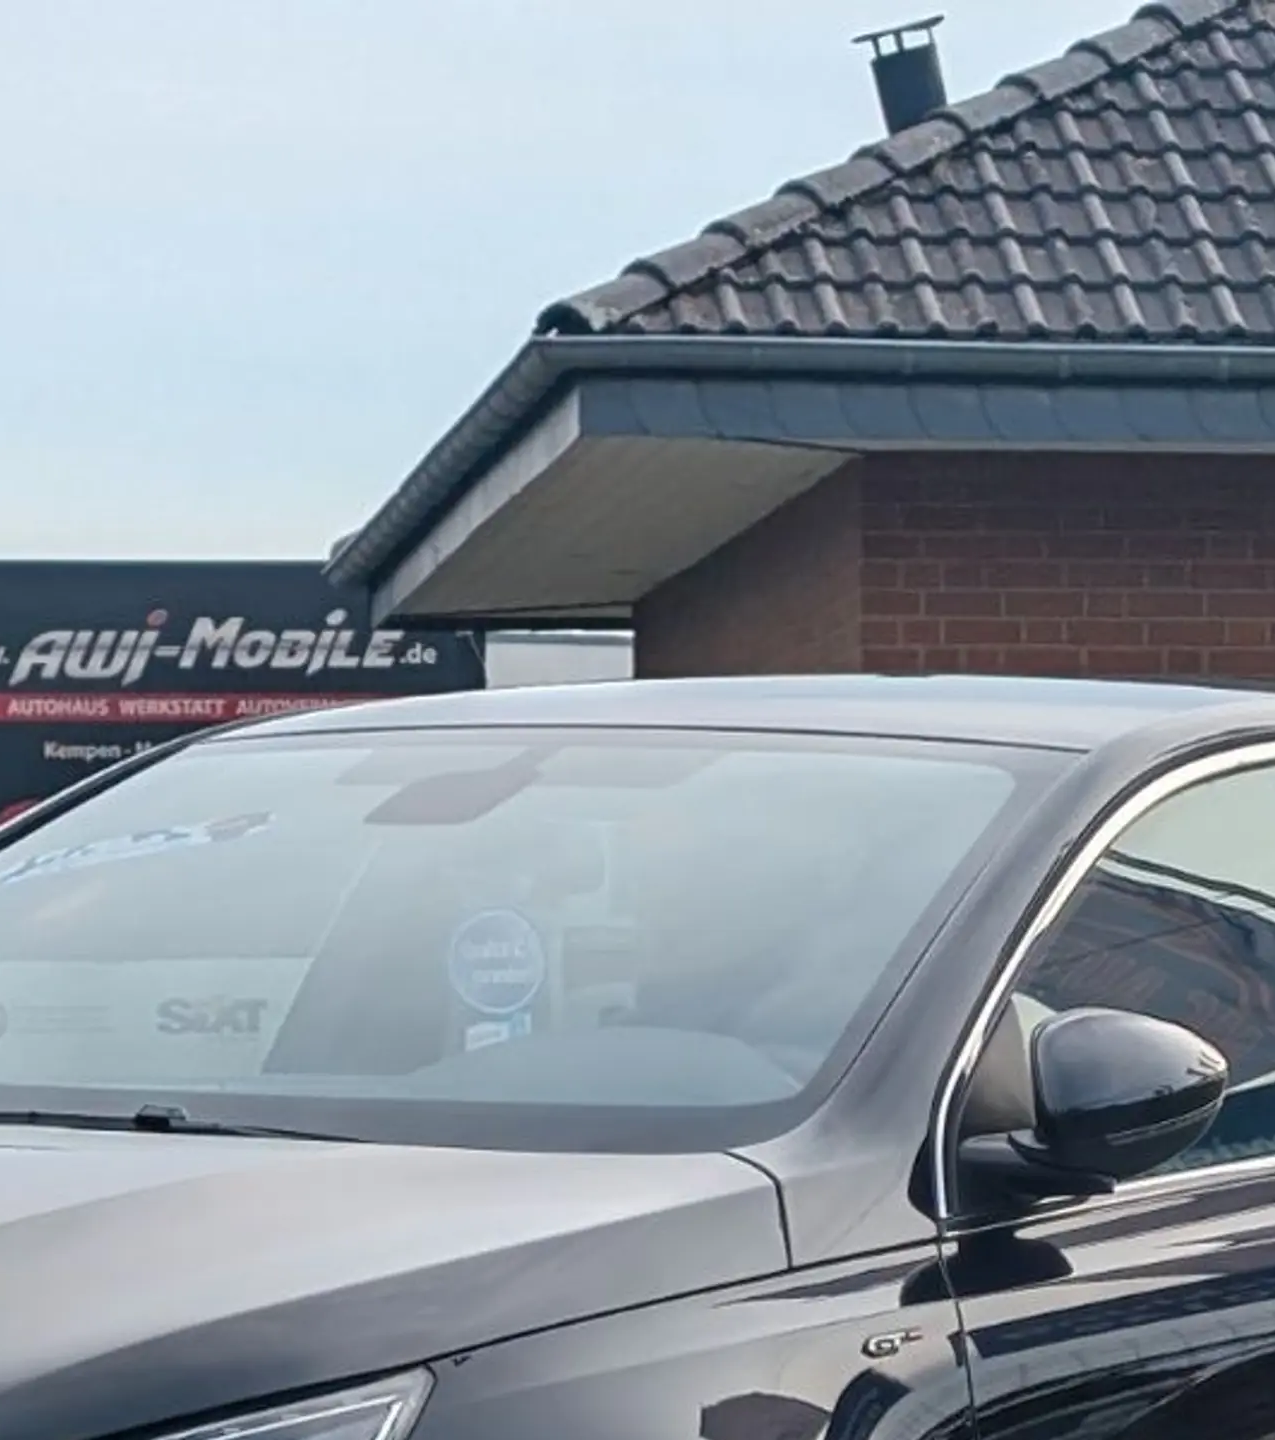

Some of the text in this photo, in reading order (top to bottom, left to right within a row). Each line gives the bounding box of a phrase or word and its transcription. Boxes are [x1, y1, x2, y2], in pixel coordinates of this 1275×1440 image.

[6, 698, 110, 717] AUTOHAUS
[118, 698, 225, 716] WERKSTATT
[43, 741, 122, 763] Kempen
